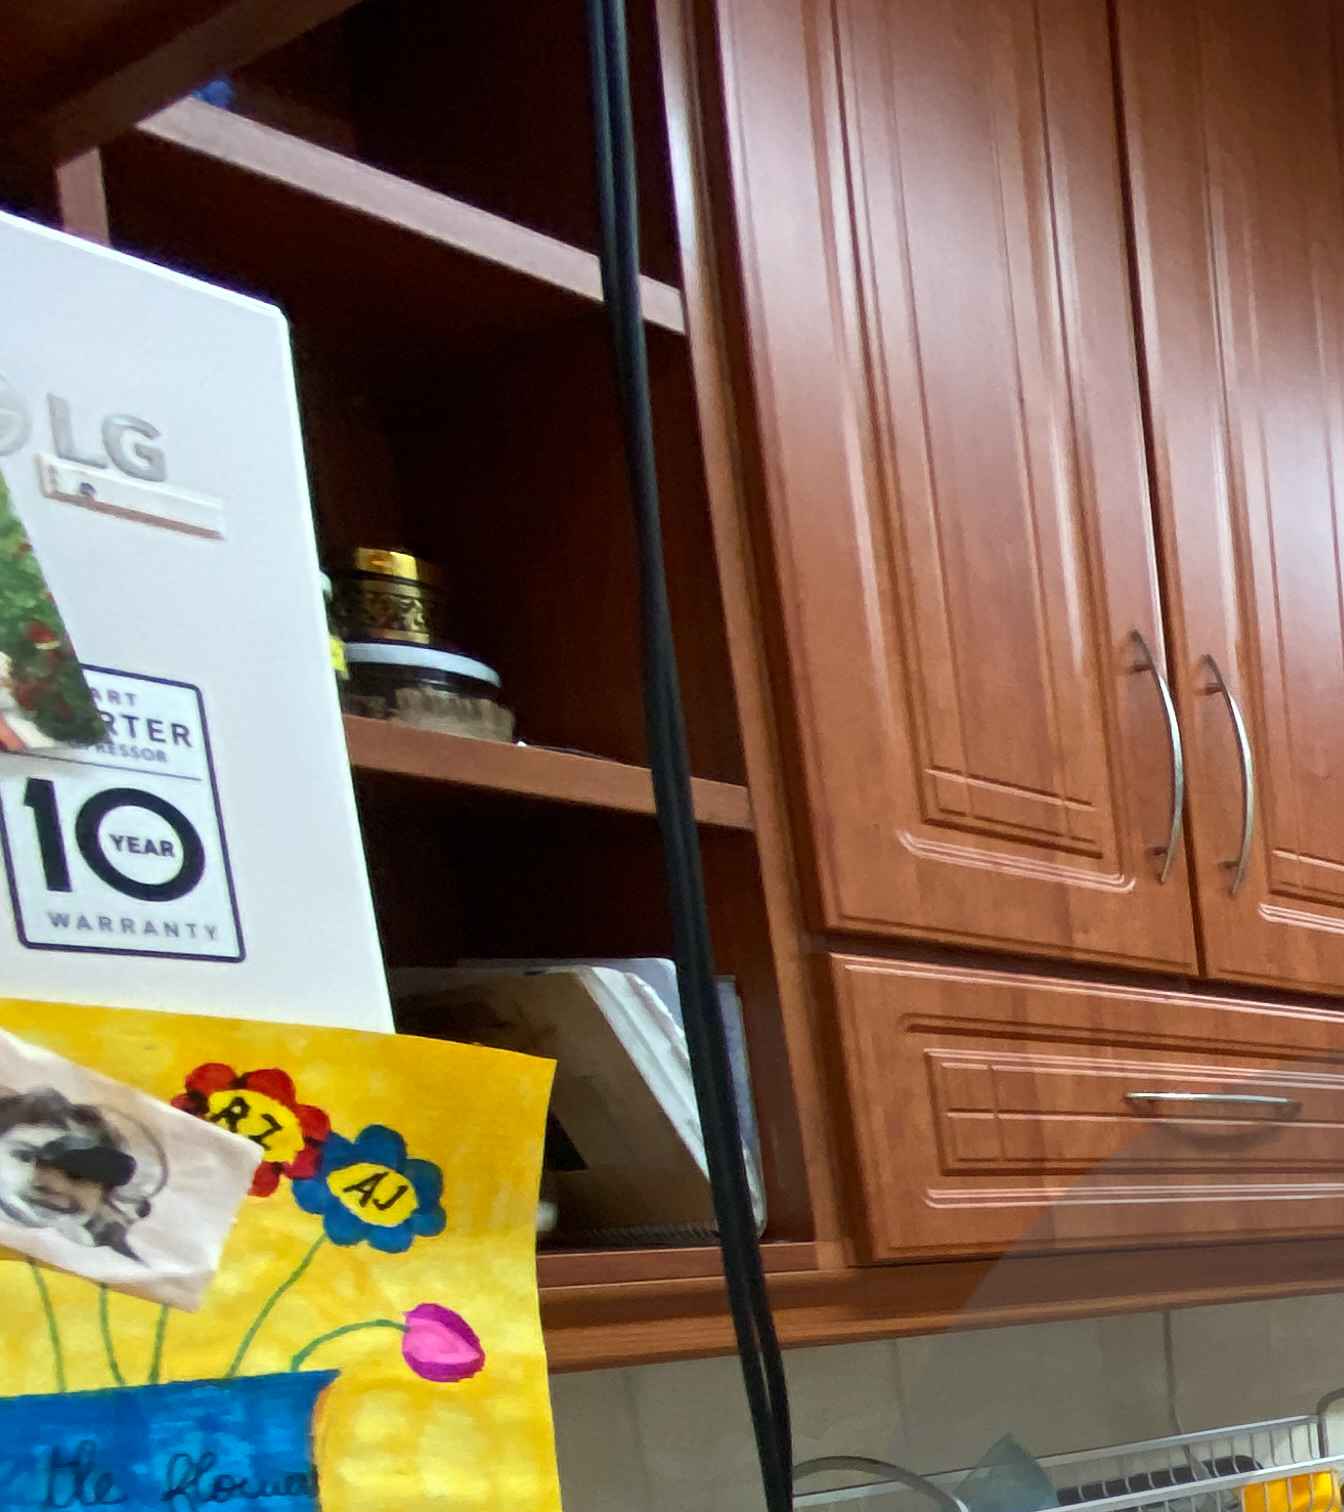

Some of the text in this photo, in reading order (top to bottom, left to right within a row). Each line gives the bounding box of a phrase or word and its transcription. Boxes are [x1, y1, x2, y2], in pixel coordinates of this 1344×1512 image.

[46, 392, 167, 482] LG
[90, 688, 136, 706] ART
[97, 710, 192, 748] RTER
[95, 743, 168, 763] RESSOR
[24, 776, 206, 902] 10
[109, 833, 175, 858] YEAR
[48, 912, 219, 941] WARRANTY
[343, 1172, 408, 1211] AJ
